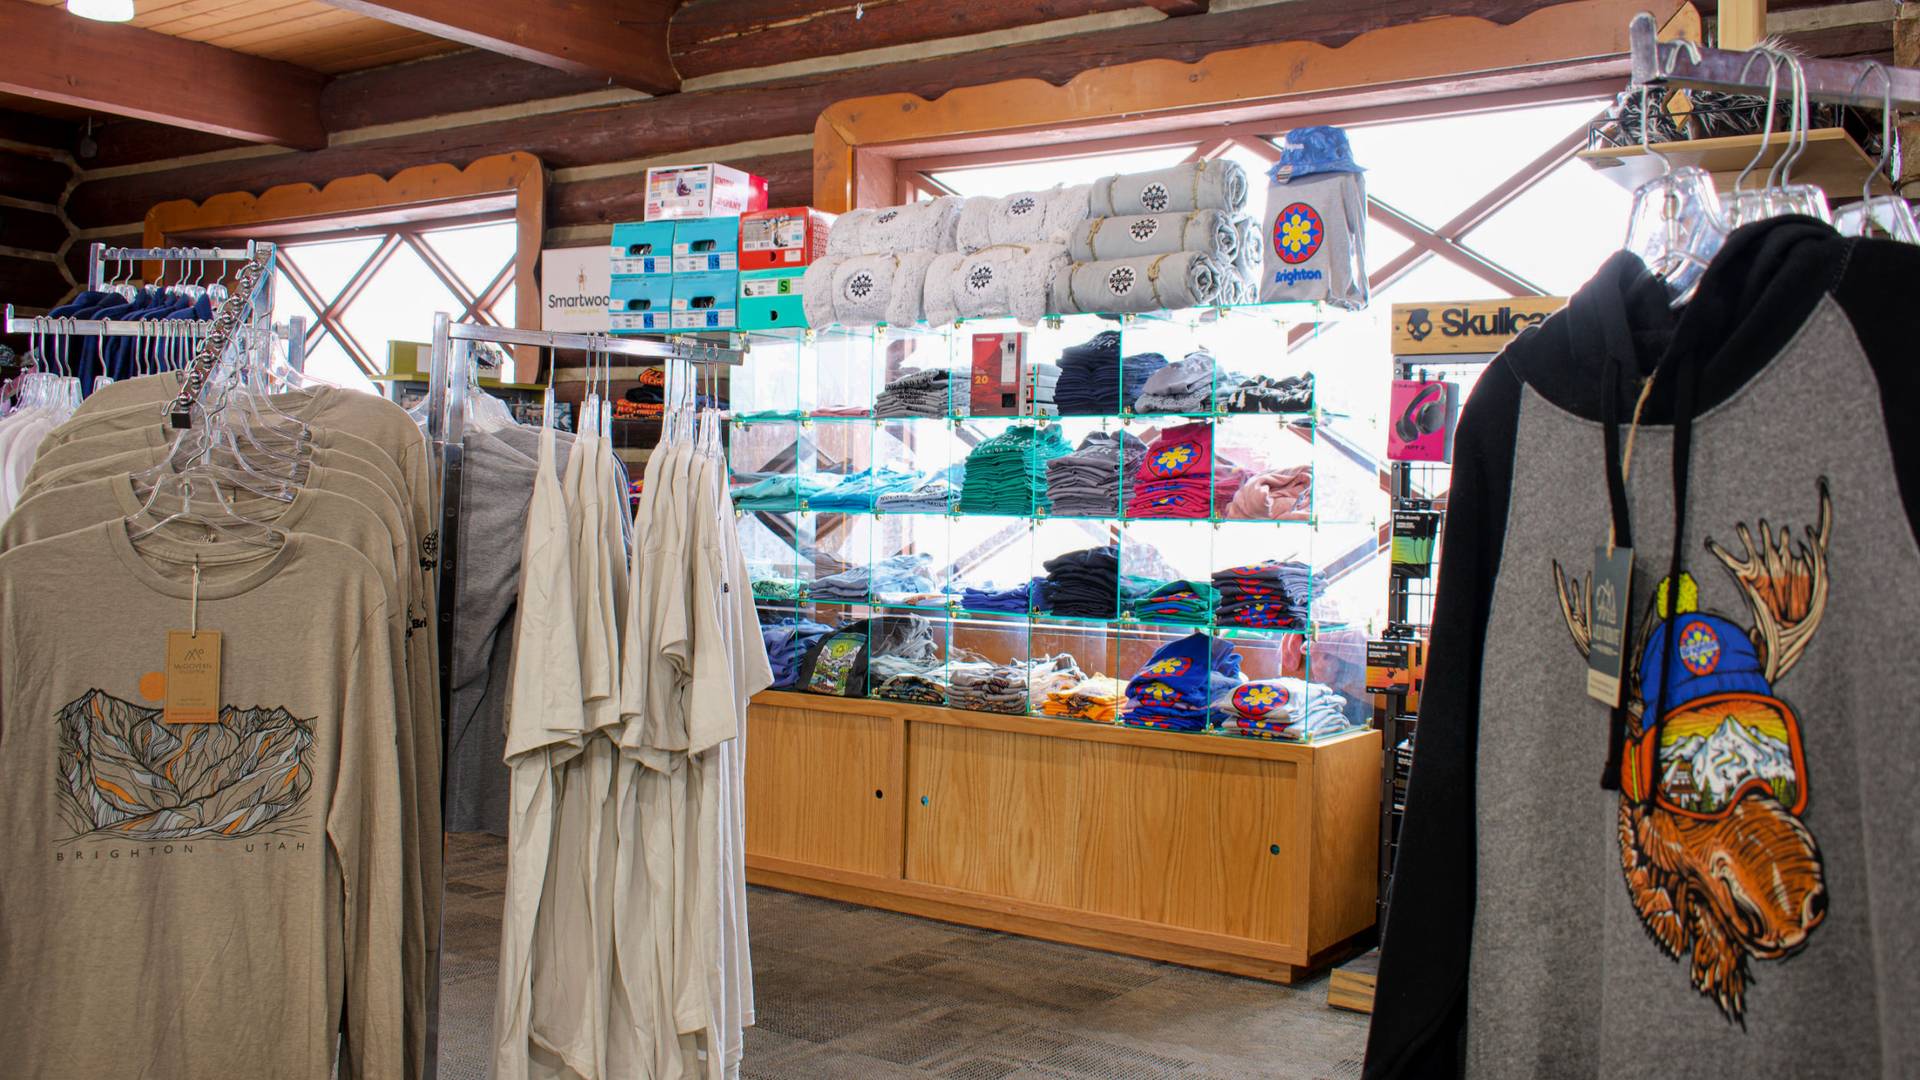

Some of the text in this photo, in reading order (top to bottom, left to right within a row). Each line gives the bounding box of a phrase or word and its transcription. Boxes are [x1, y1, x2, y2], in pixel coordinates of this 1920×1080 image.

[780, 280, 788, 293] S
[548, 293, 610, 309] Smartwoo
[1441, 307, 1552, 337] Skullca
[974, 375, 989, 385] 20
[56, 842, 305, 862] BRIGHTON UTAH
